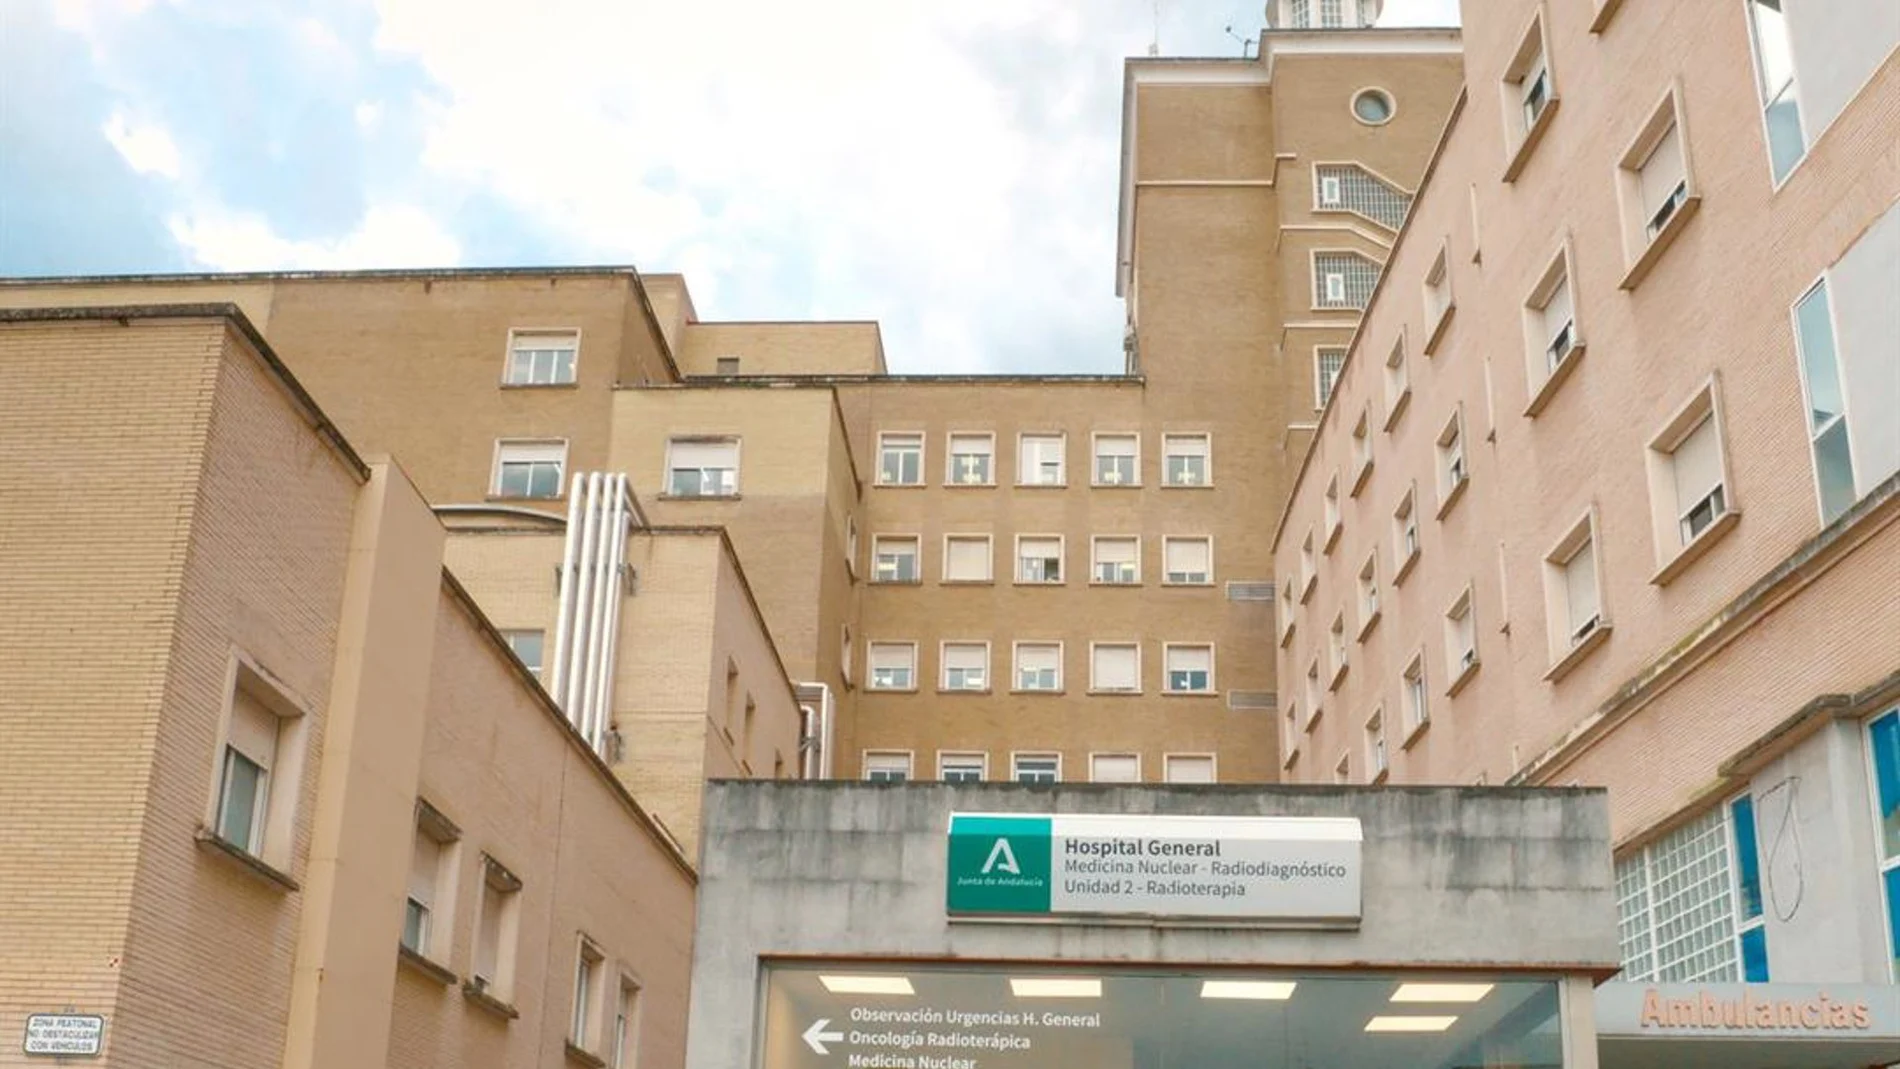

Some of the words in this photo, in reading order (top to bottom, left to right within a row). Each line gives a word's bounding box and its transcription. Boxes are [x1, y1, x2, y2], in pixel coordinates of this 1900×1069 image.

[1065, 838, 1145, 859] Hospital
[1148, 839, 1221, 858] General
[1065, 859, 1134, 875] Medicina
[1138, 860, 1198, 876] Nuclear
[1211, 861, 1347, 879] Radiodiagnóstico
[957, 877, 983, 887] Junta
[984, 877, 996, 887] de
[1065, 880, 1121, 895] Unidad
[1124, 881, 1134, 895] 2
[1147, 881, 1246, 898] Radioterapia
[850, 1007, 943, 1025] Observación
[947, 1010, 1020, 1029] Urgencias
[1023, 1011, 1039, 1026] H.
[1042, 1011, 1101, 1028] General
[1640, 988, 1872, 1030] Ambulancias
[849, 1031, 923, 1050] Oncología
[927, 1033, 1031, 1051] Radioterápica
[848, 1054, 916, 1069] Medicina
[919, 1055, 977, 1069] Nuclear
